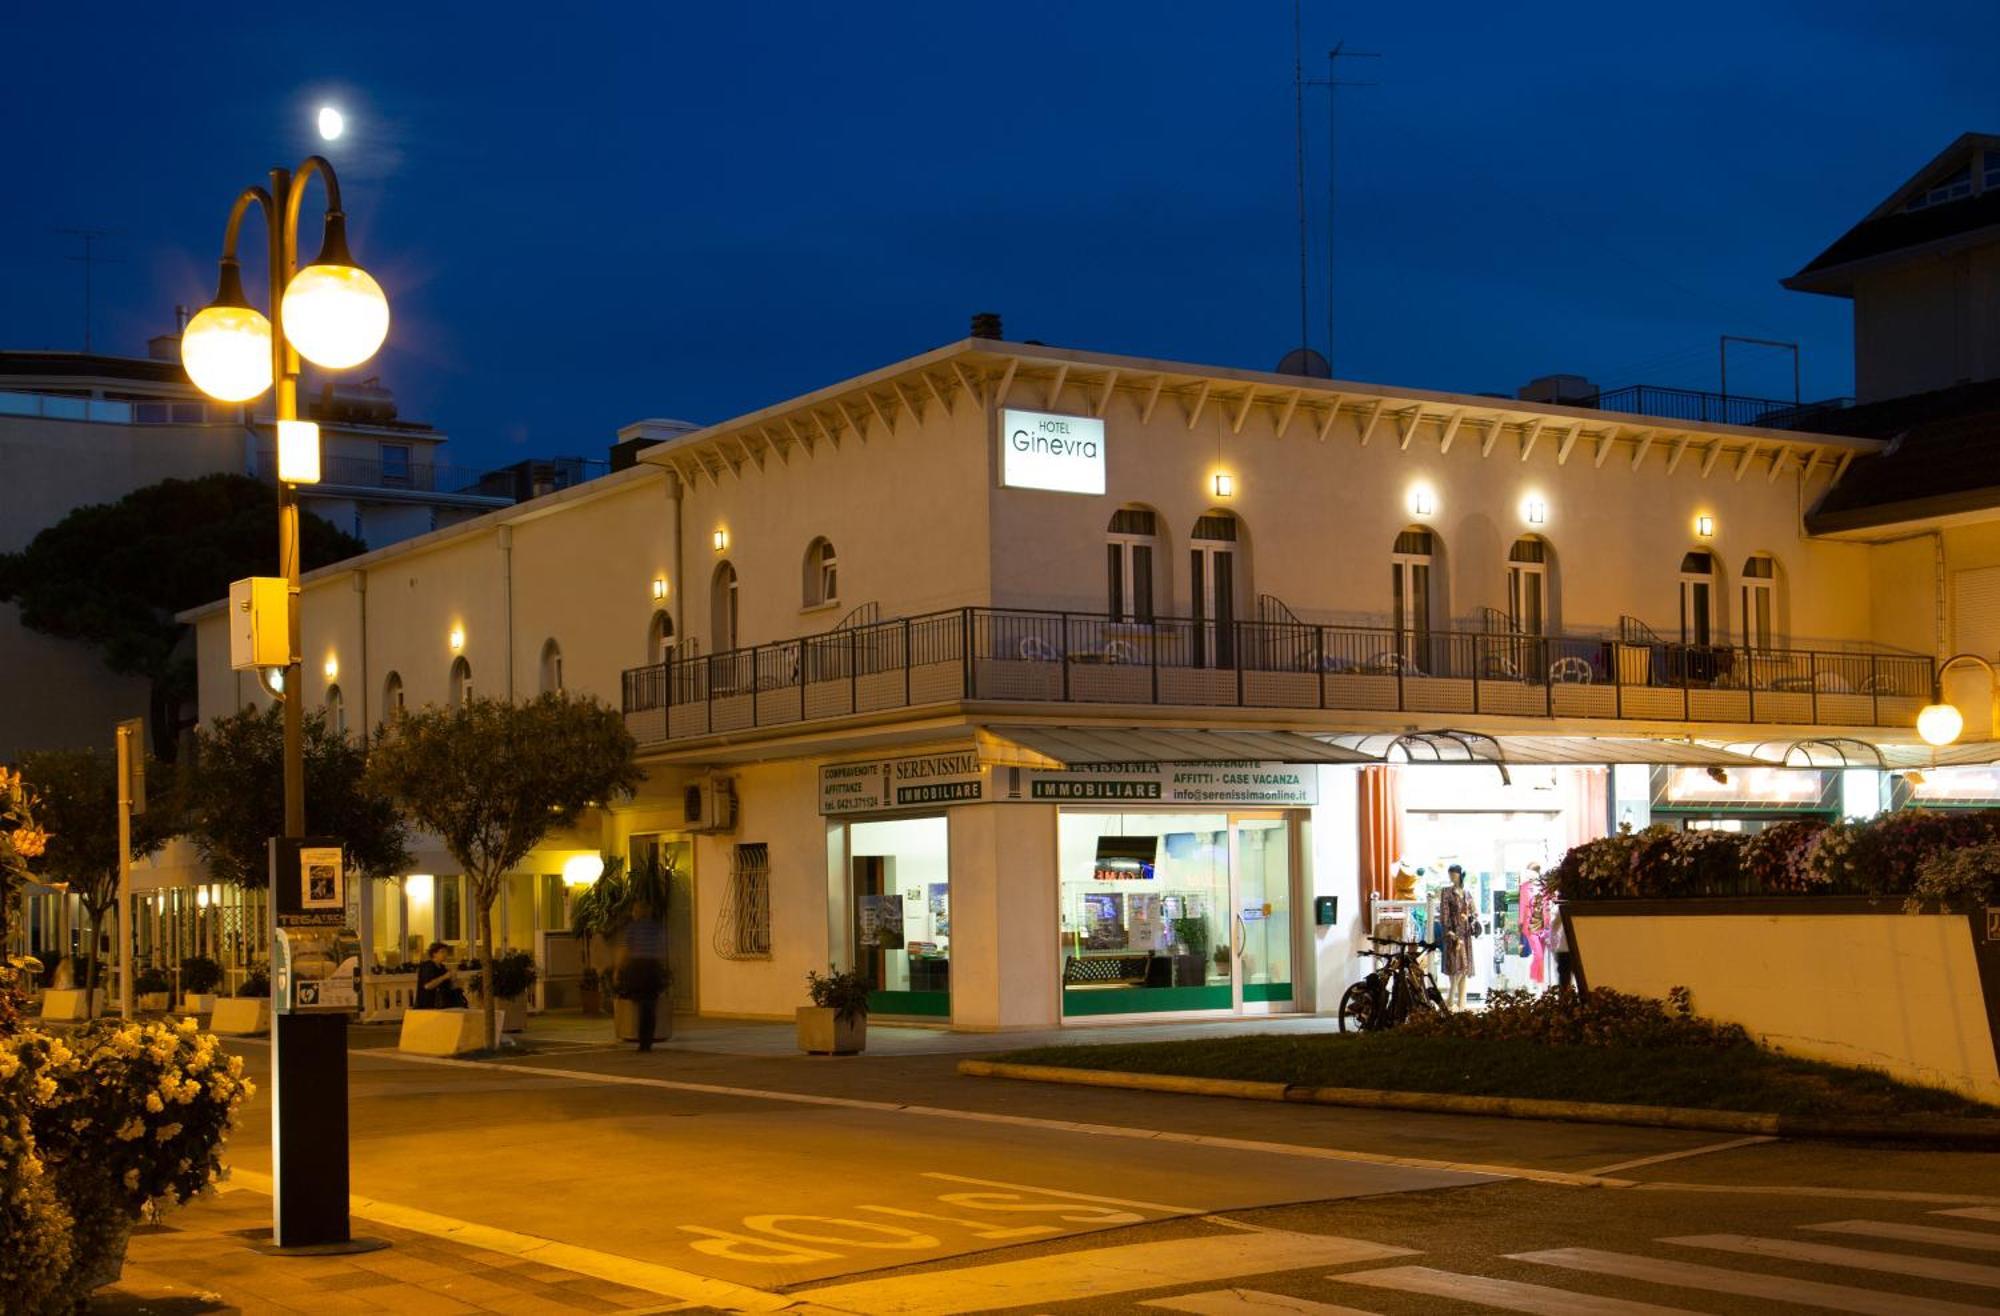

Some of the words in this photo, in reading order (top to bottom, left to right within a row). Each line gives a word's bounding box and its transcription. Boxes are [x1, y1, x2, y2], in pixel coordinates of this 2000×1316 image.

[1039, 420, 1071, 434] HOTEL
[1012, 429, 1097, 458] Ginevra
[896, 755, 981, 779] SERENISSIMA
[1173, 773, 1213, 785] AFFITTI
[1222, 773, 1249, 785] CASE
[1252, 774, 1300, 785] VACANZA
[899, 783, 979, 802] IMMOBILIARE
[1036, 782, 1158, 797] IMMOBILIARE
[1173, 789, 1307, 802] info@serenissimaonline.it
[677, 1191, 1146, 1264] STOP
